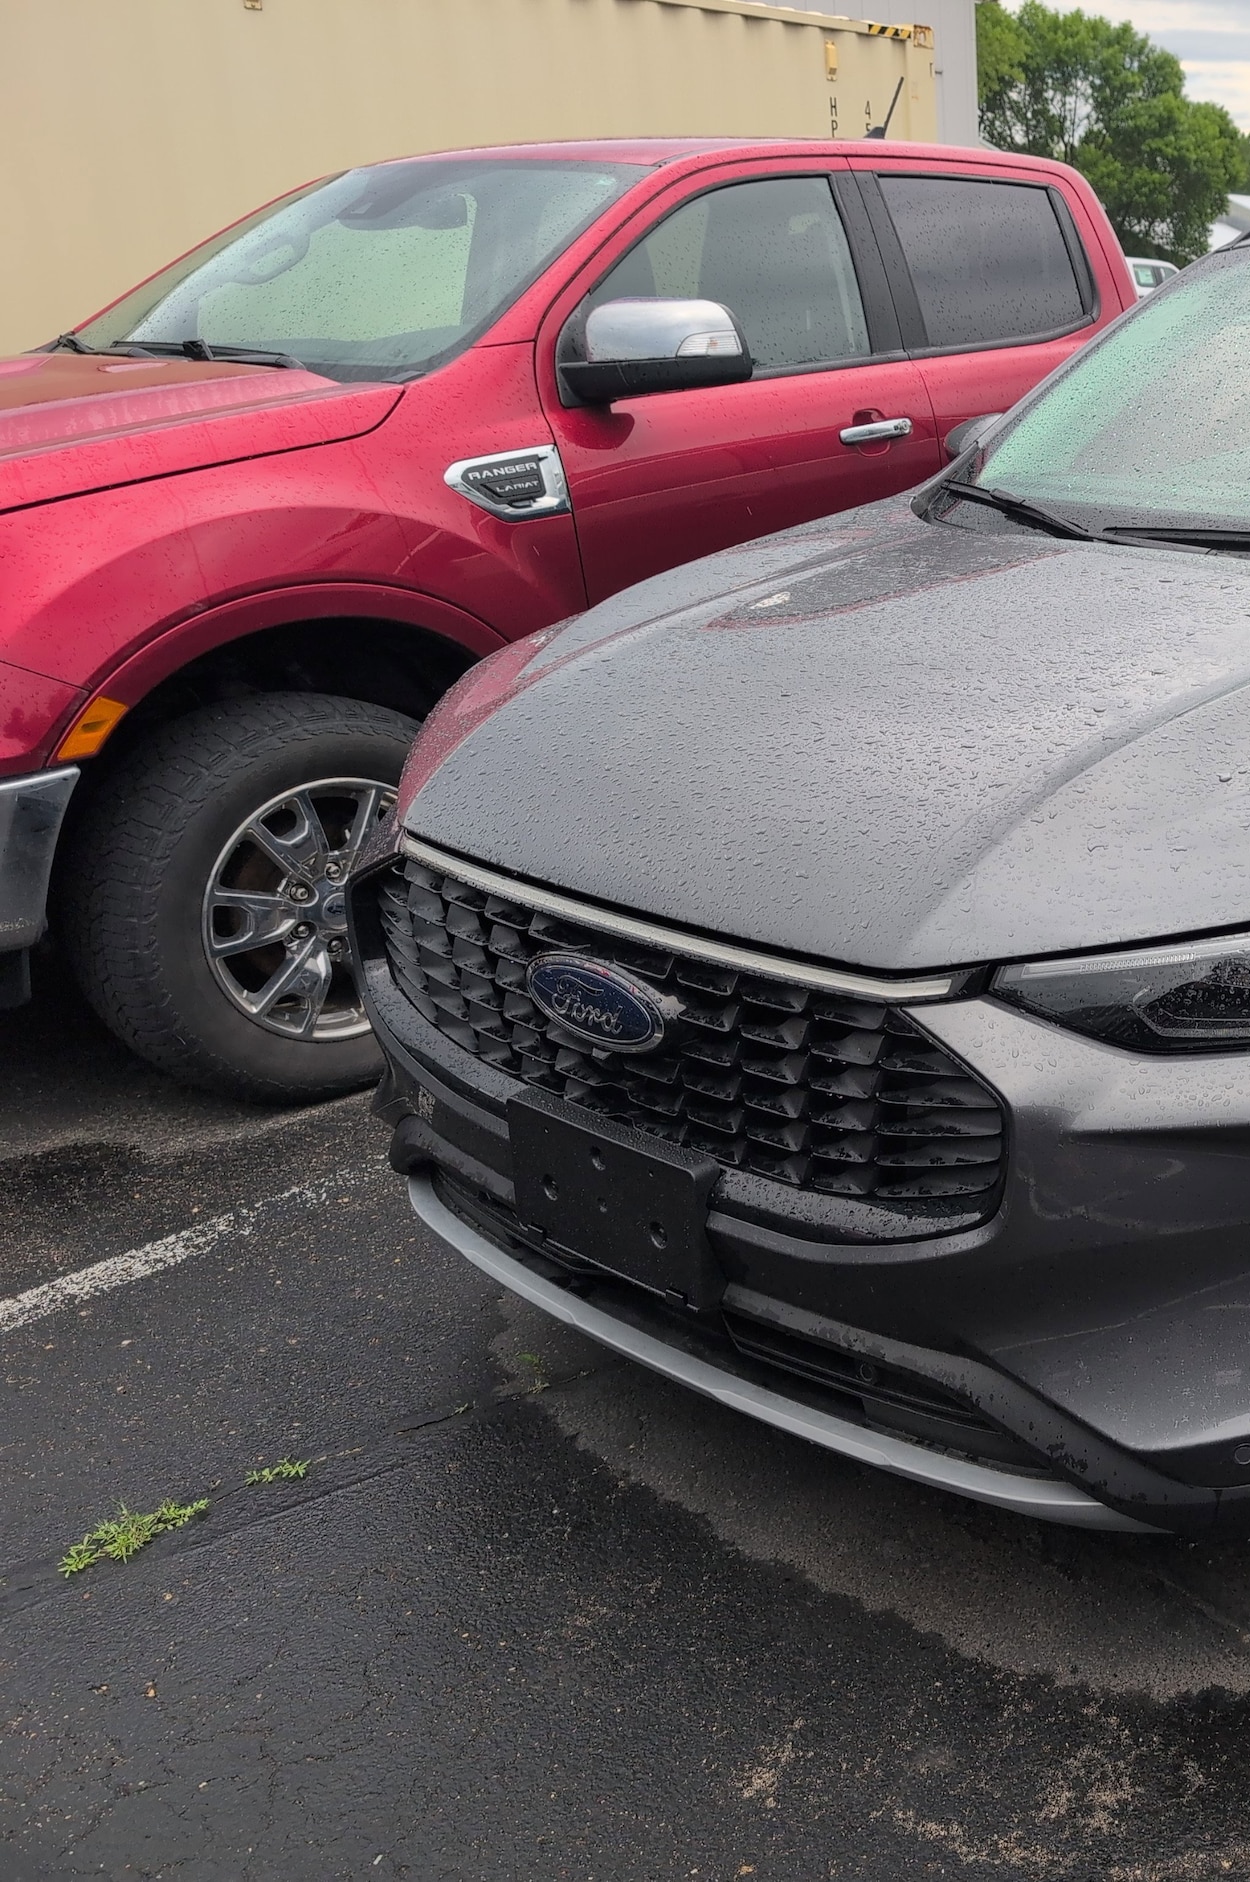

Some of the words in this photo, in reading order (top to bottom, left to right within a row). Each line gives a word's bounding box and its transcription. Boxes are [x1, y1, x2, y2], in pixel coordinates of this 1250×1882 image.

[467, 461, 538, 481] RANGER
[495, 480, 539, 493] LARIAT
[551, 974, 624, 1035] Ford
